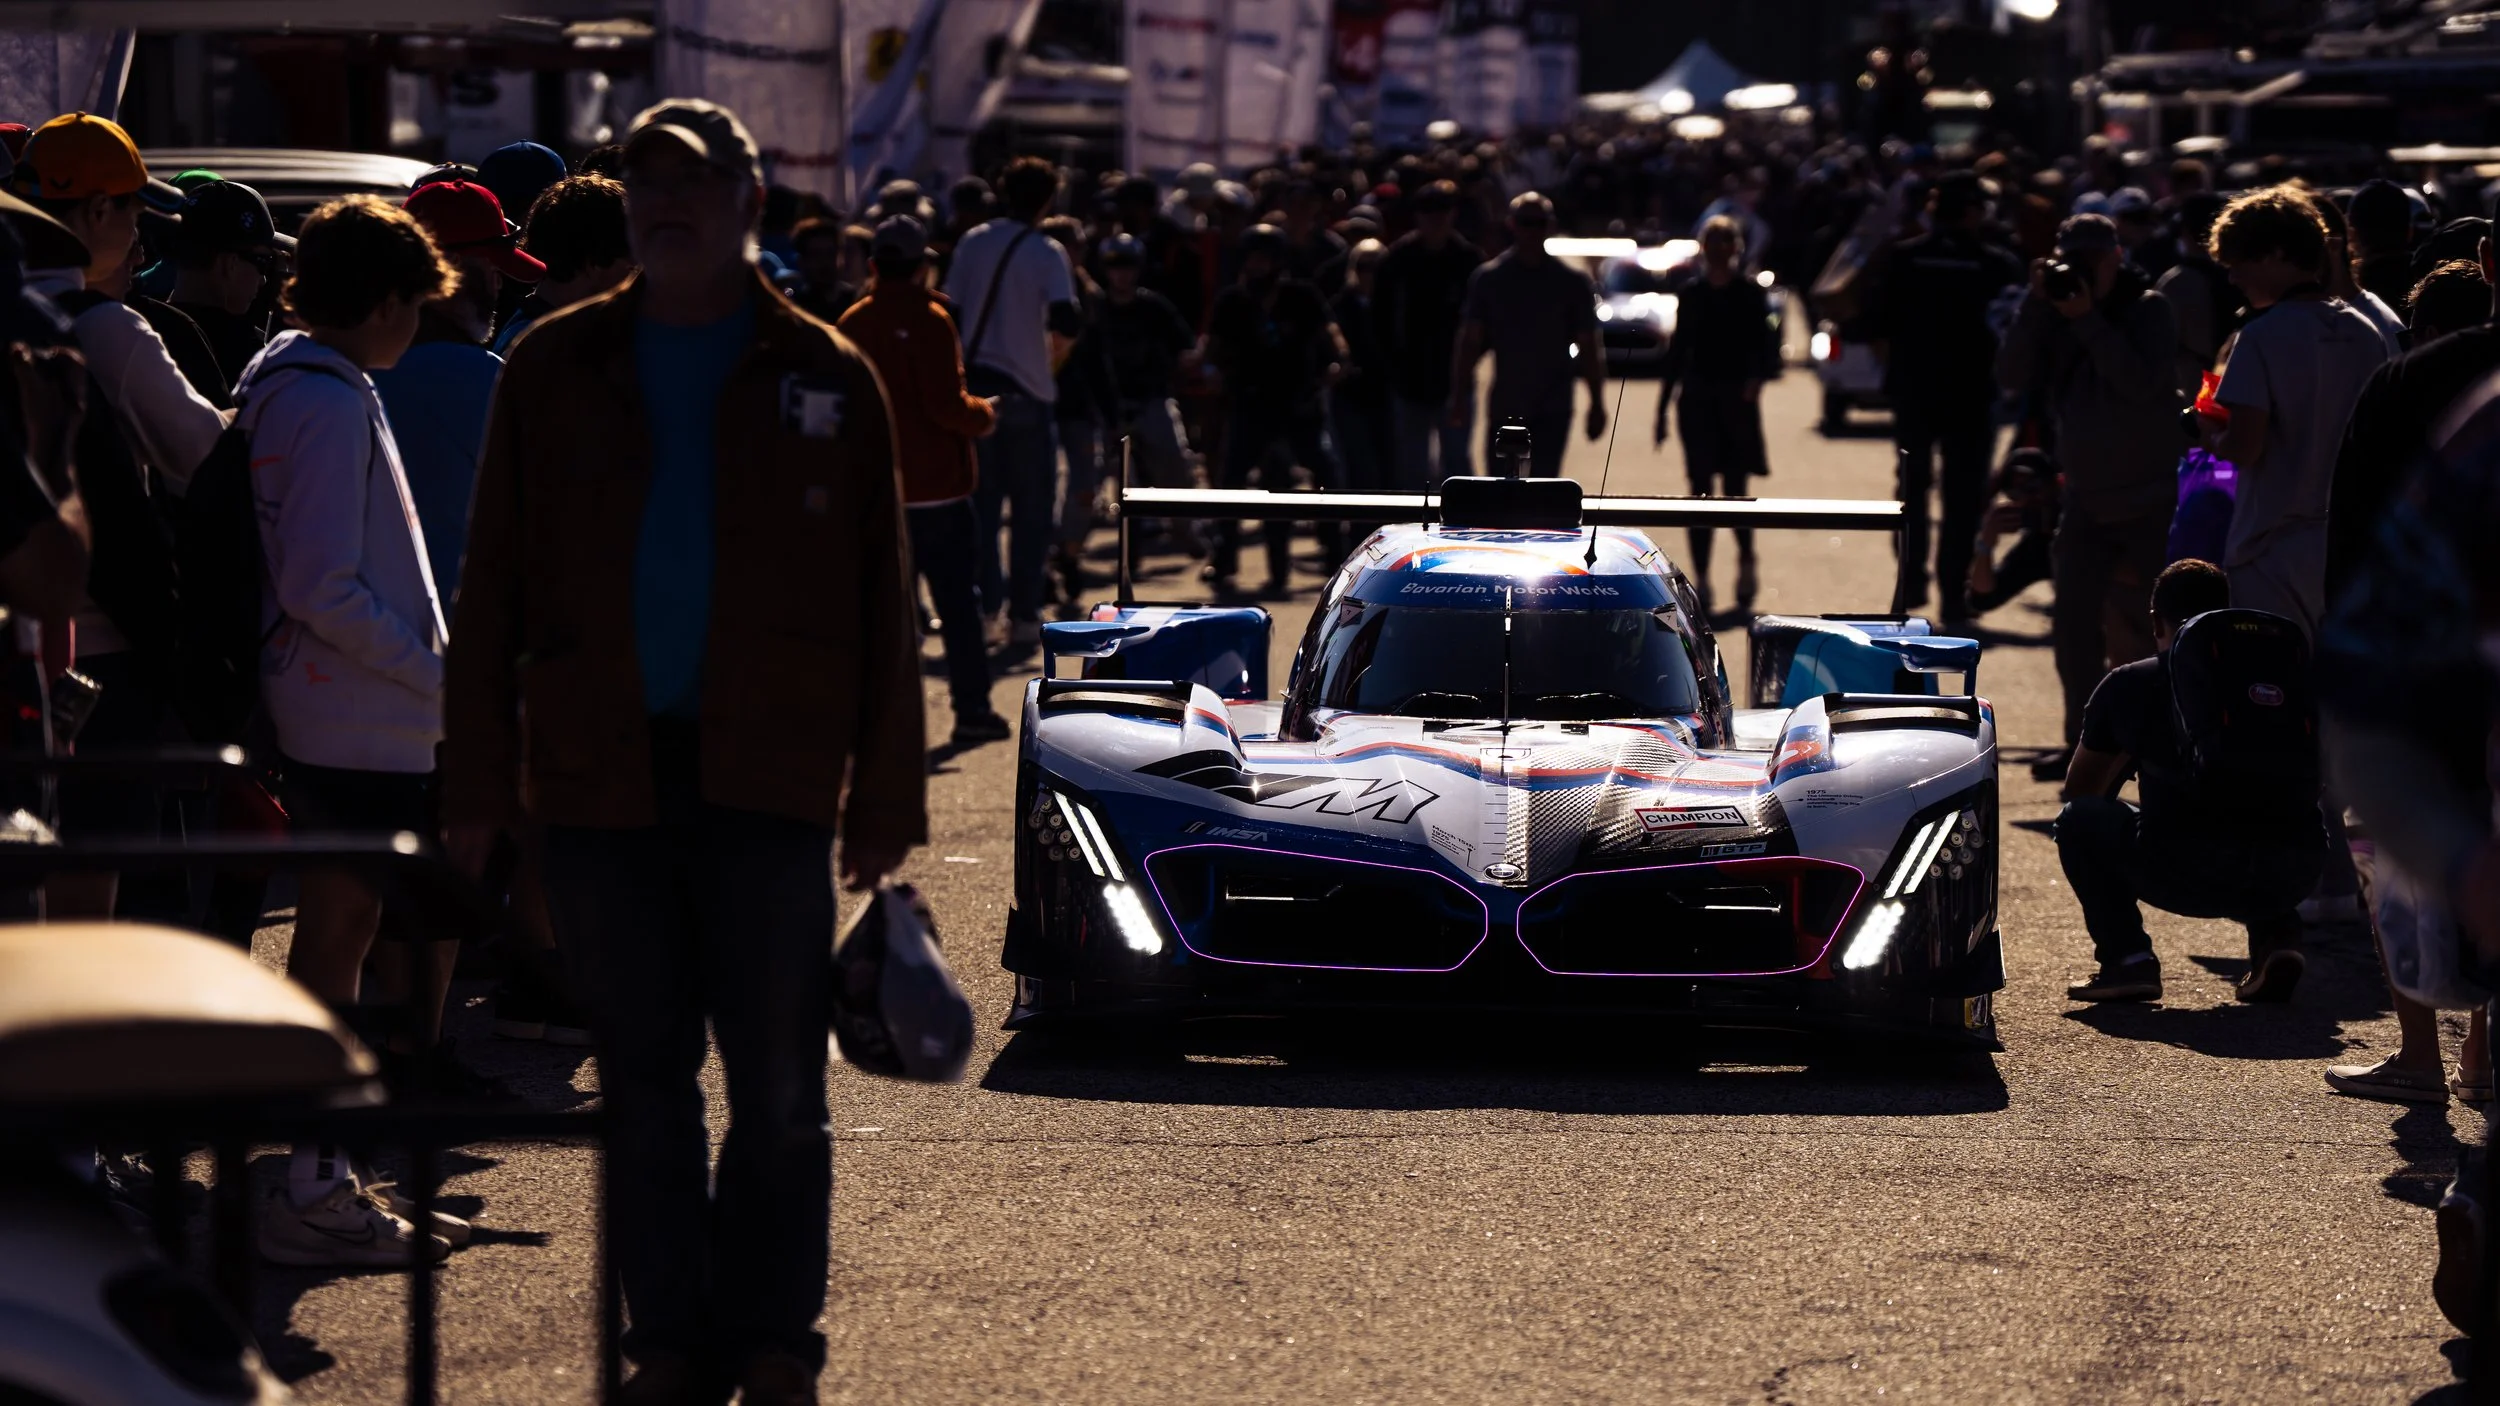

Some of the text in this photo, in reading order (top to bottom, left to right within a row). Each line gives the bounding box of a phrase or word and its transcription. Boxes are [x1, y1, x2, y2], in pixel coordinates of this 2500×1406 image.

[1400, 582, 1620, 597] Bavarian Motor Works
[1645, 811, 1738, 824] CHAMPION
[1206, 826, 1268, 842] IMSA
[1432, 824, 1456, 840] March
[1432, 829, 1450, 841] 1975
[1721, 844, 1763, 854] GTP
